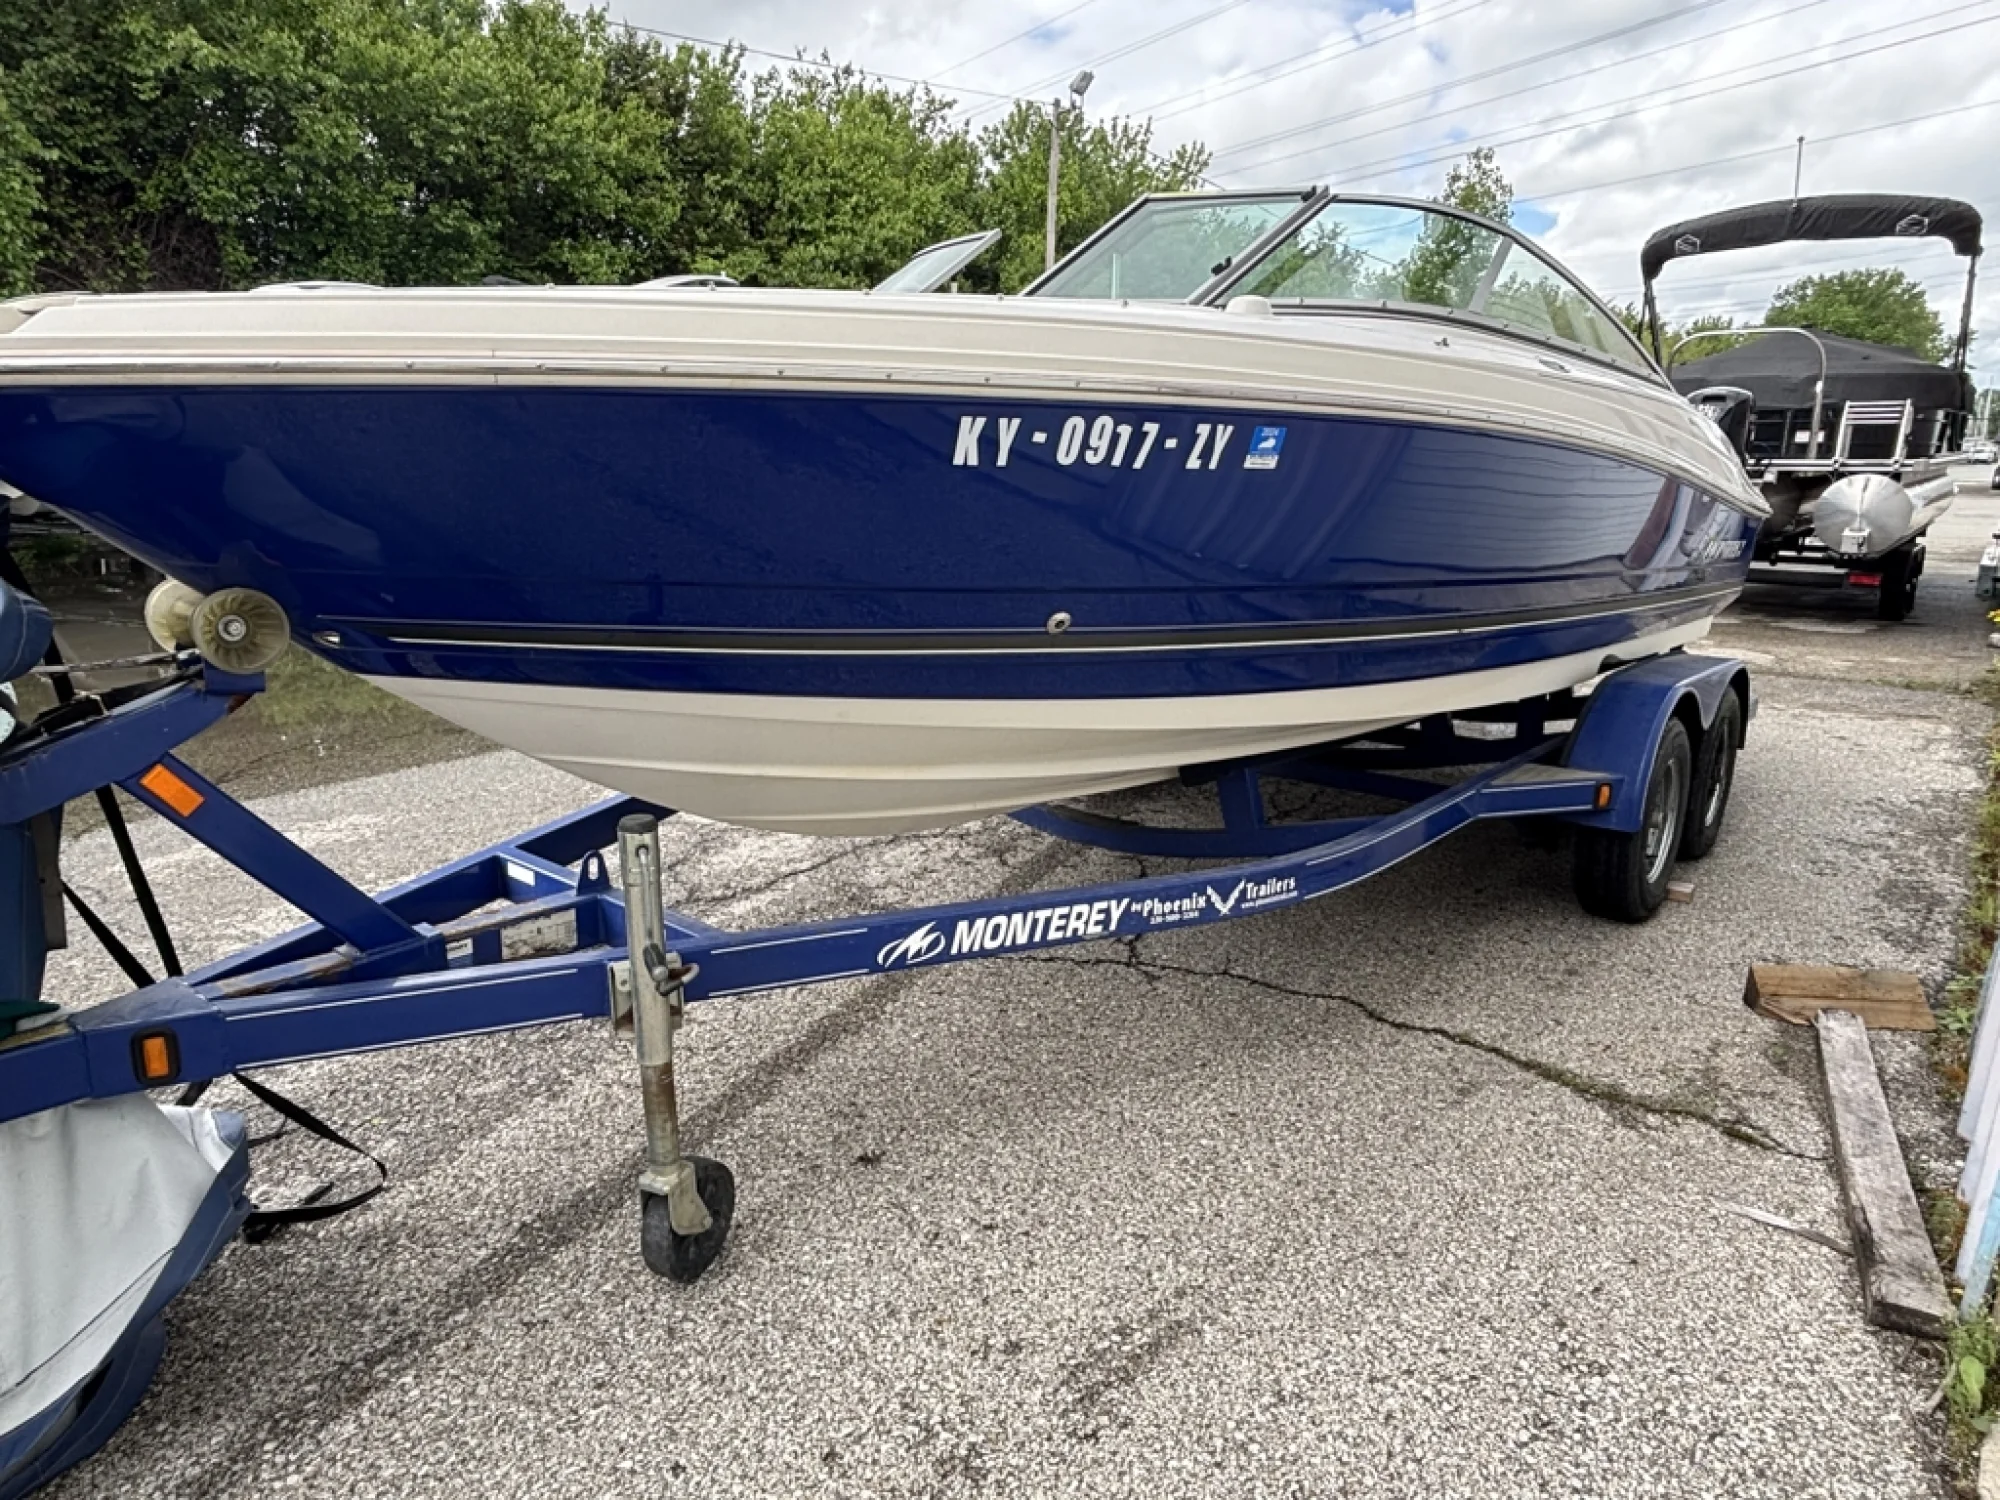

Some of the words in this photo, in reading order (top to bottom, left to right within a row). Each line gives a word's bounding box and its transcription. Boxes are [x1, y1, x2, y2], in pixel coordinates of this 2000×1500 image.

[953, 416, 1021, 467] KY
[1056, 416, 1160, 469] 0917
[1185, 424, 1234, 469] ZY
[950, 898, 1130, 954] MONTEREY
[1142, 892, 1207, 917] Phoenix
[1246, 877, 1296, 899] Trailers
